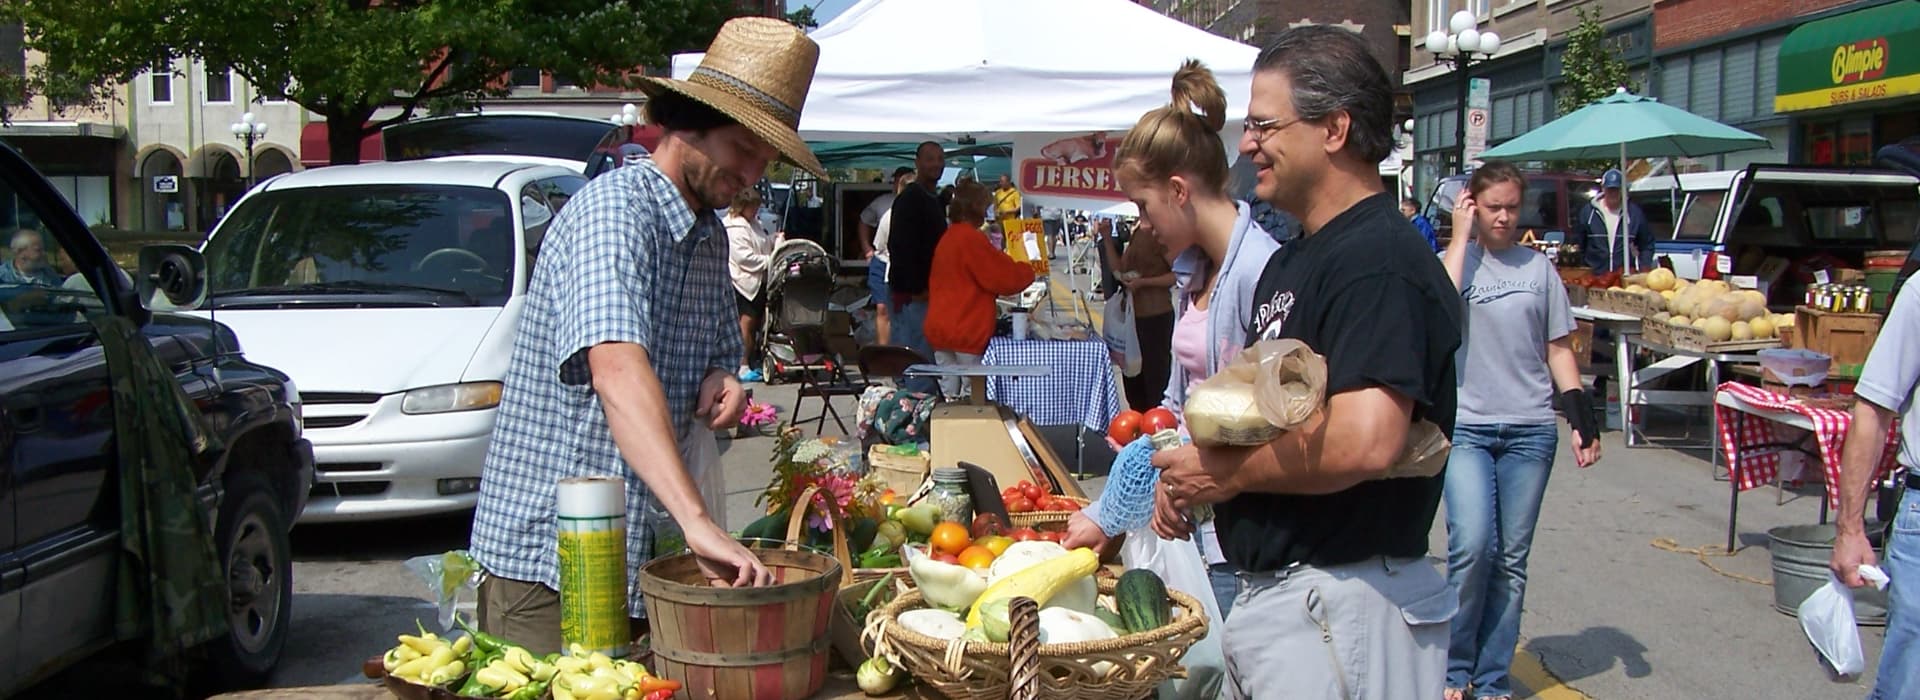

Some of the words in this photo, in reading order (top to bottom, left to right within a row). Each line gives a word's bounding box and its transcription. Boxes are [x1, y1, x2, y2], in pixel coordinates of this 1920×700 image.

[1831, 40, 1884, 84] Blimpie
[1830, 91, 1849, 104] SUBS
[1858, 84, 1887, 99] SALADS
[1033, 164, 1122, 192] JERSE
